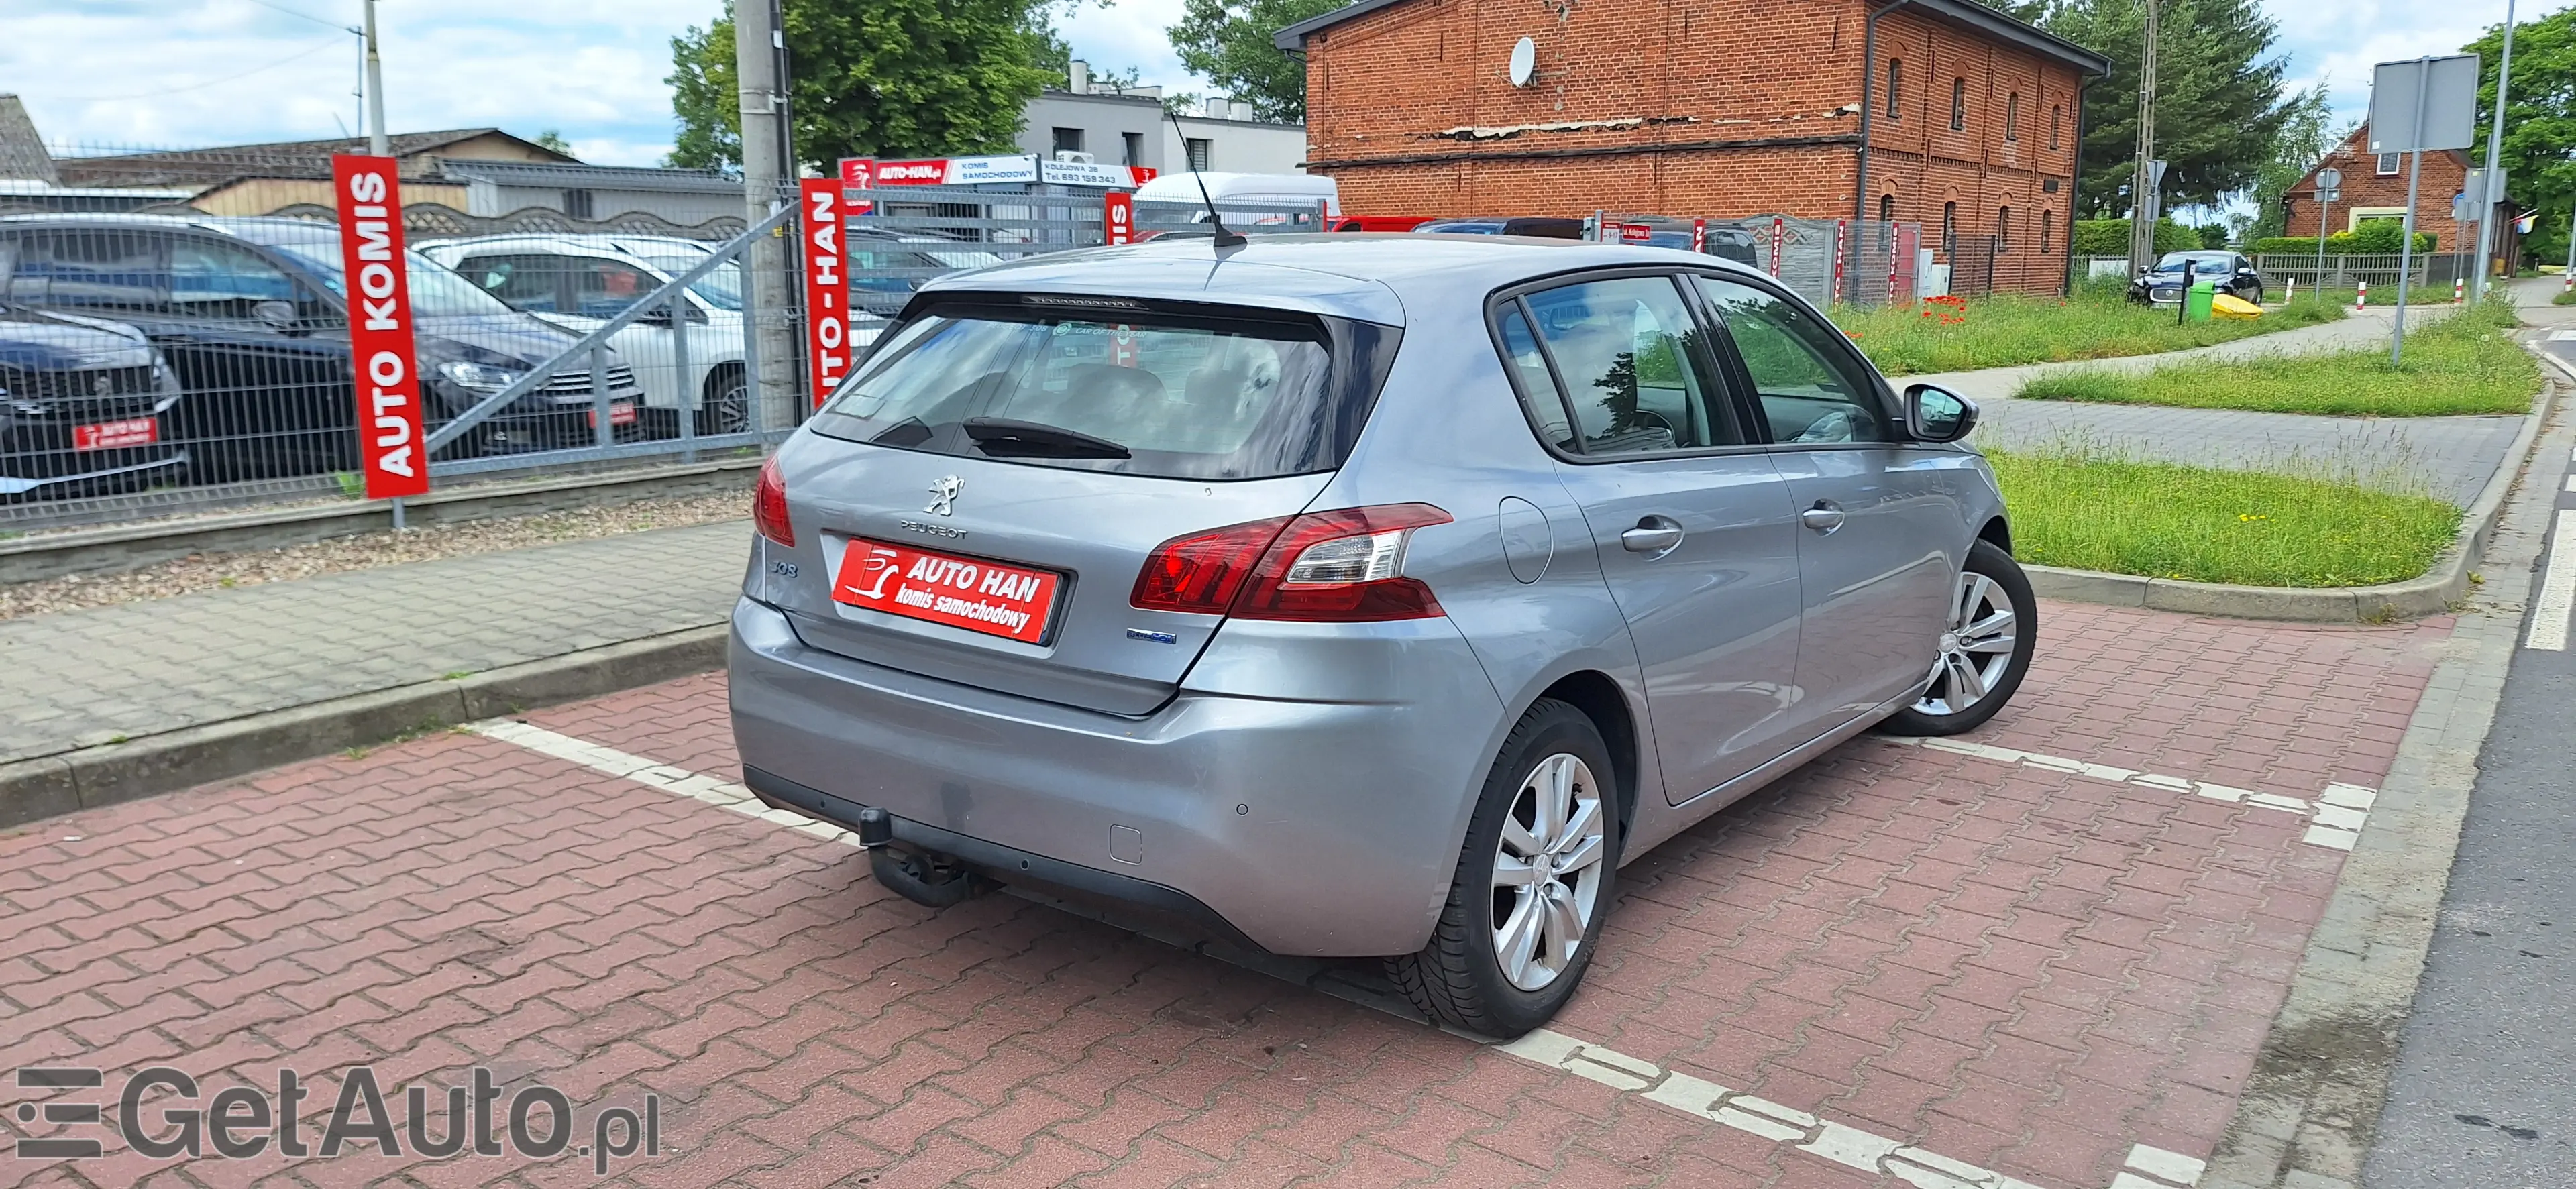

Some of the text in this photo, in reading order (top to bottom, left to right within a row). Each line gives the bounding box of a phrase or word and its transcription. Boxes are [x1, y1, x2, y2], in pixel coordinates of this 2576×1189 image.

[879, 166, 941, 180] AUTO-HAN.pl
[962, 170, 1033, 180] SAMOCHODOWY
[1044, 164, 1086, 172] KOLEJOWA
[1045, 172, 1116, 184] Tel. 693 159 343
[1890, 227, 1898, 275] KOMIS
[350, 171, 414, 479] AUTO KOMIS
[900, 520, 969, 540] PEUGEOT
[906, 557, 1041, 603] AUTO HAN
[894, 583, 1031, 634] komis samochodowy
